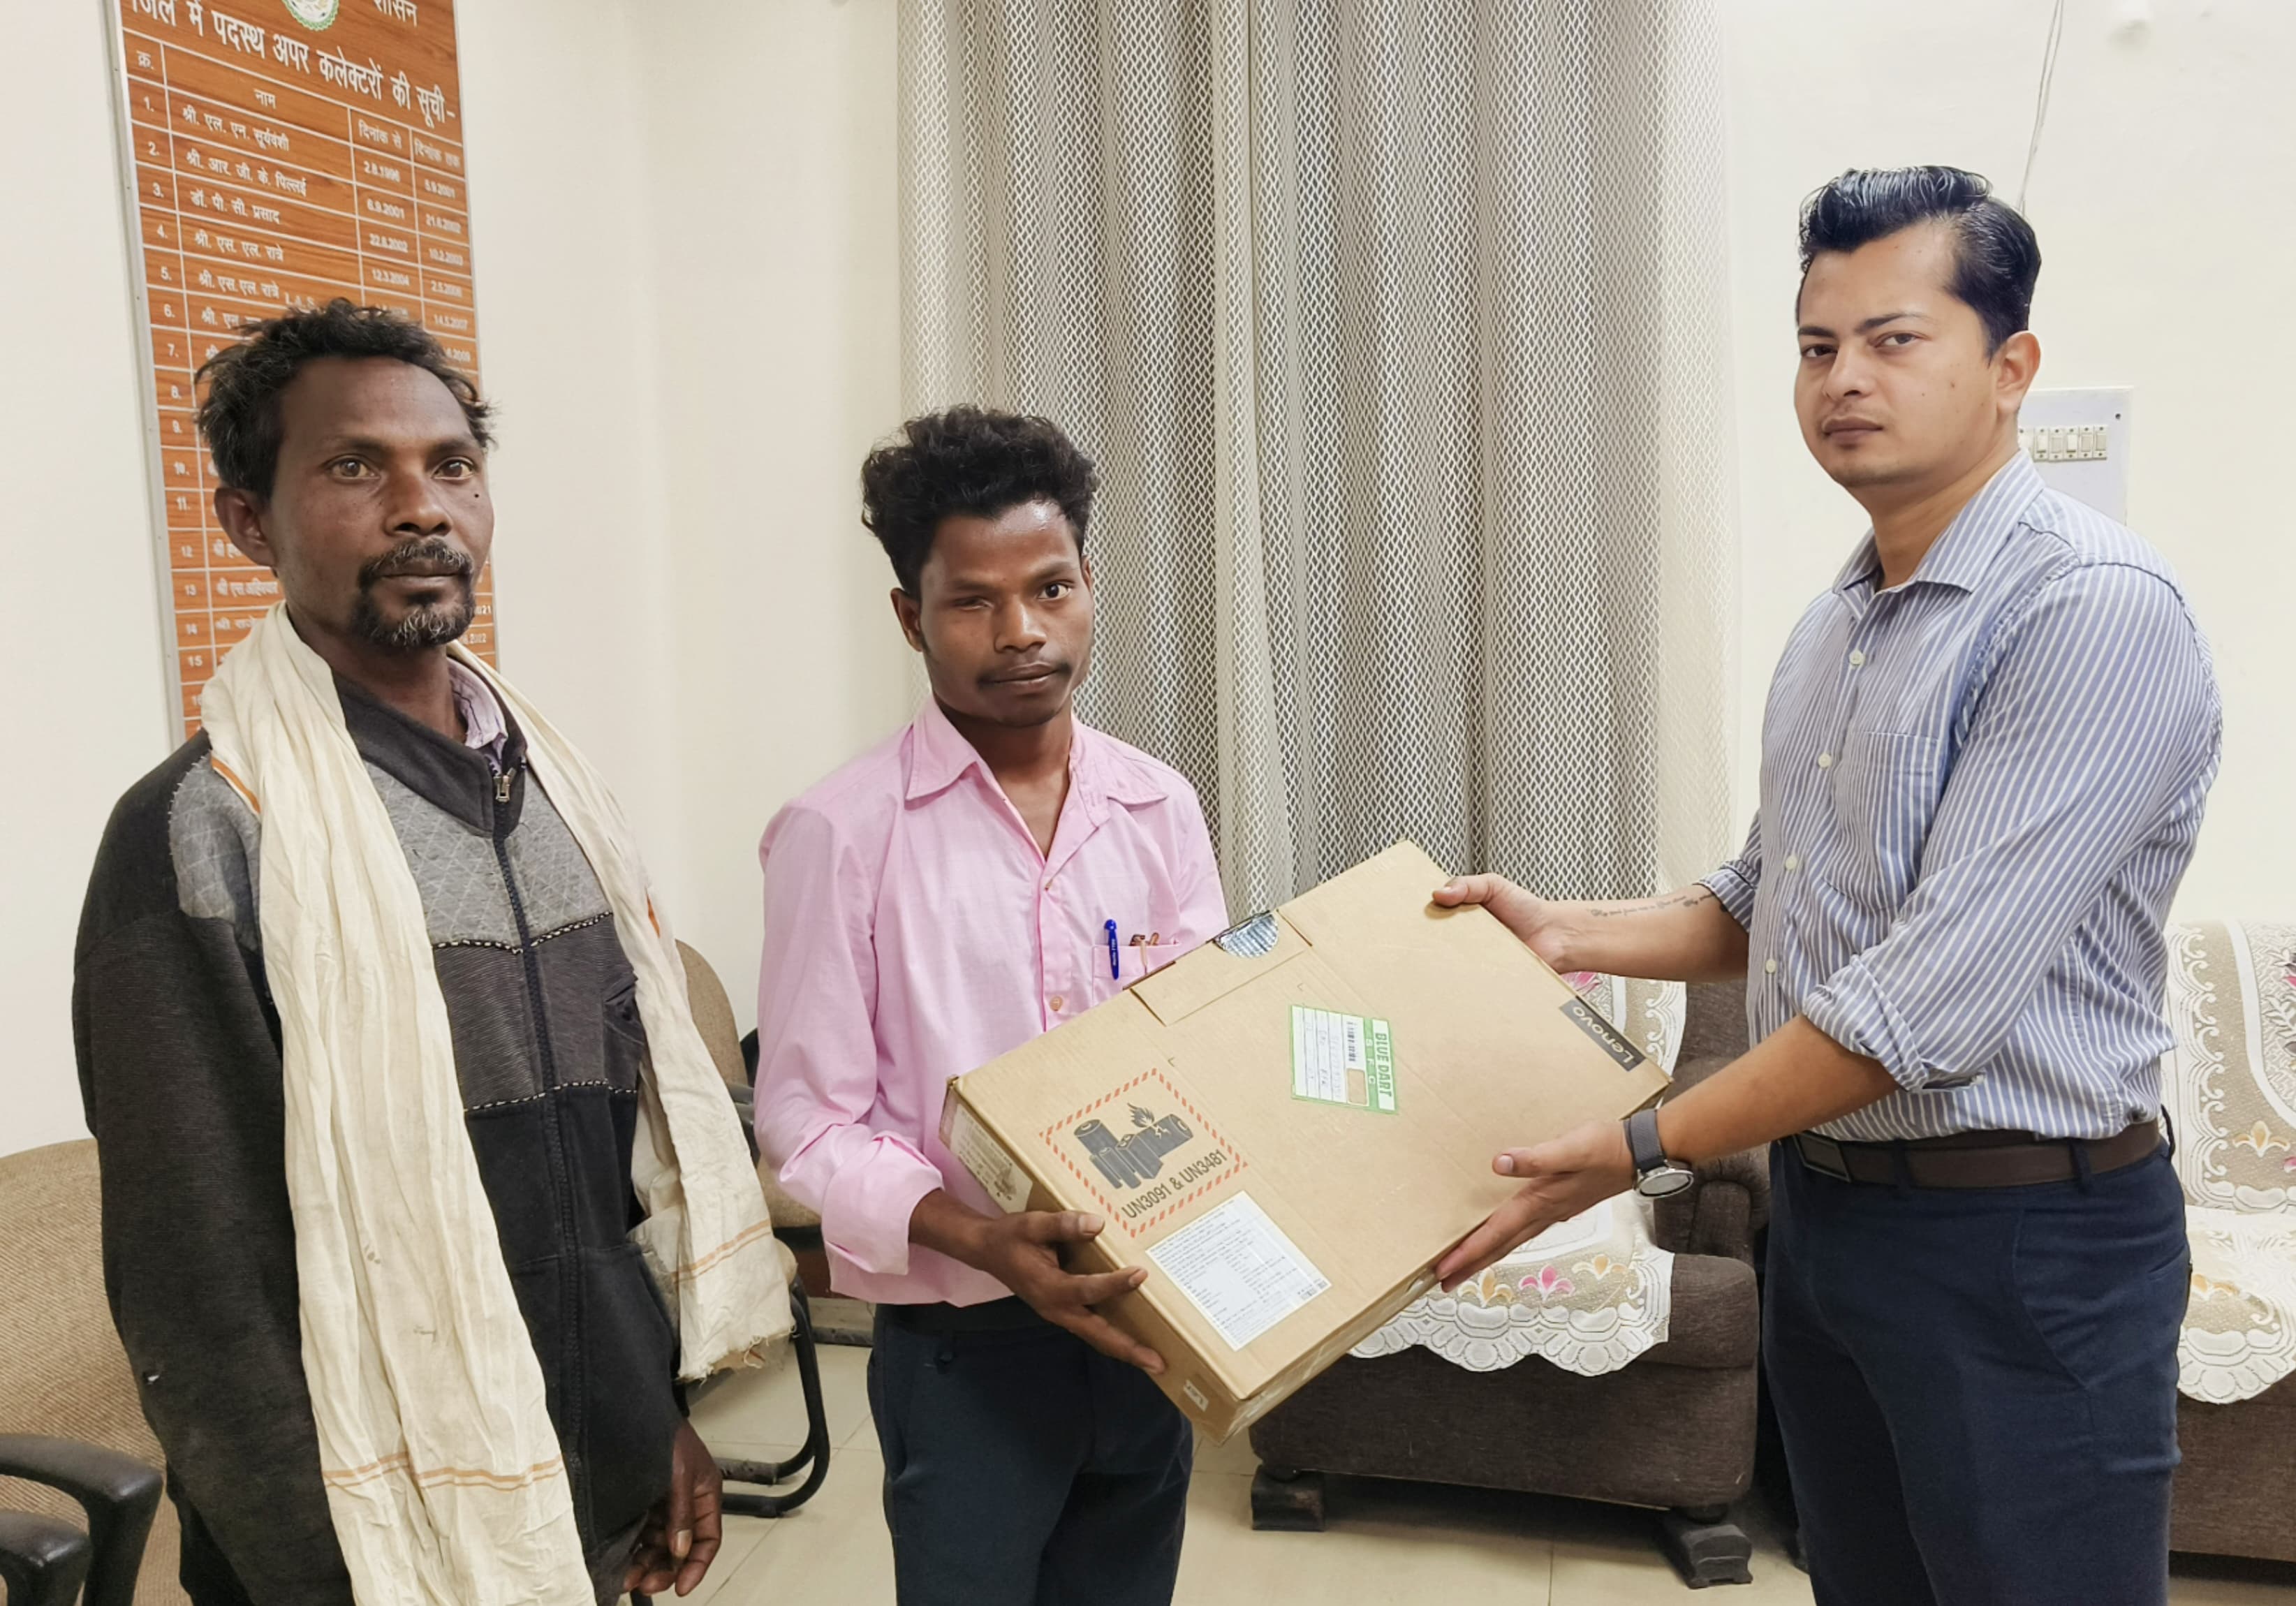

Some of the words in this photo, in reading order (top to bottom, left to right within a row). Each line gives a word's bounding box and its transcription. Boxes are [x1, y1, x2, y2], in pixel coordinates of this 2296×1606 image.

[211, 9, 265, 59] पदस्थ
[272, 34, 310, 75] अपर
[316, 45, 384, 101] कलेक्टरों
[389, 71, 411, 110] की
[253, 88, 277, 110] नाम
[1375, 1032, 1389, 1062] BLUE
[1573, 1006, 1635, 1063] Lenovo
[1378, 1063, 1392, 1098] DART
[1121, 1183, 1172, 1218] UN3091
[1169, 1177, 1184, 1191] &
[1179, 1149, 1228, 1183] UN3481
